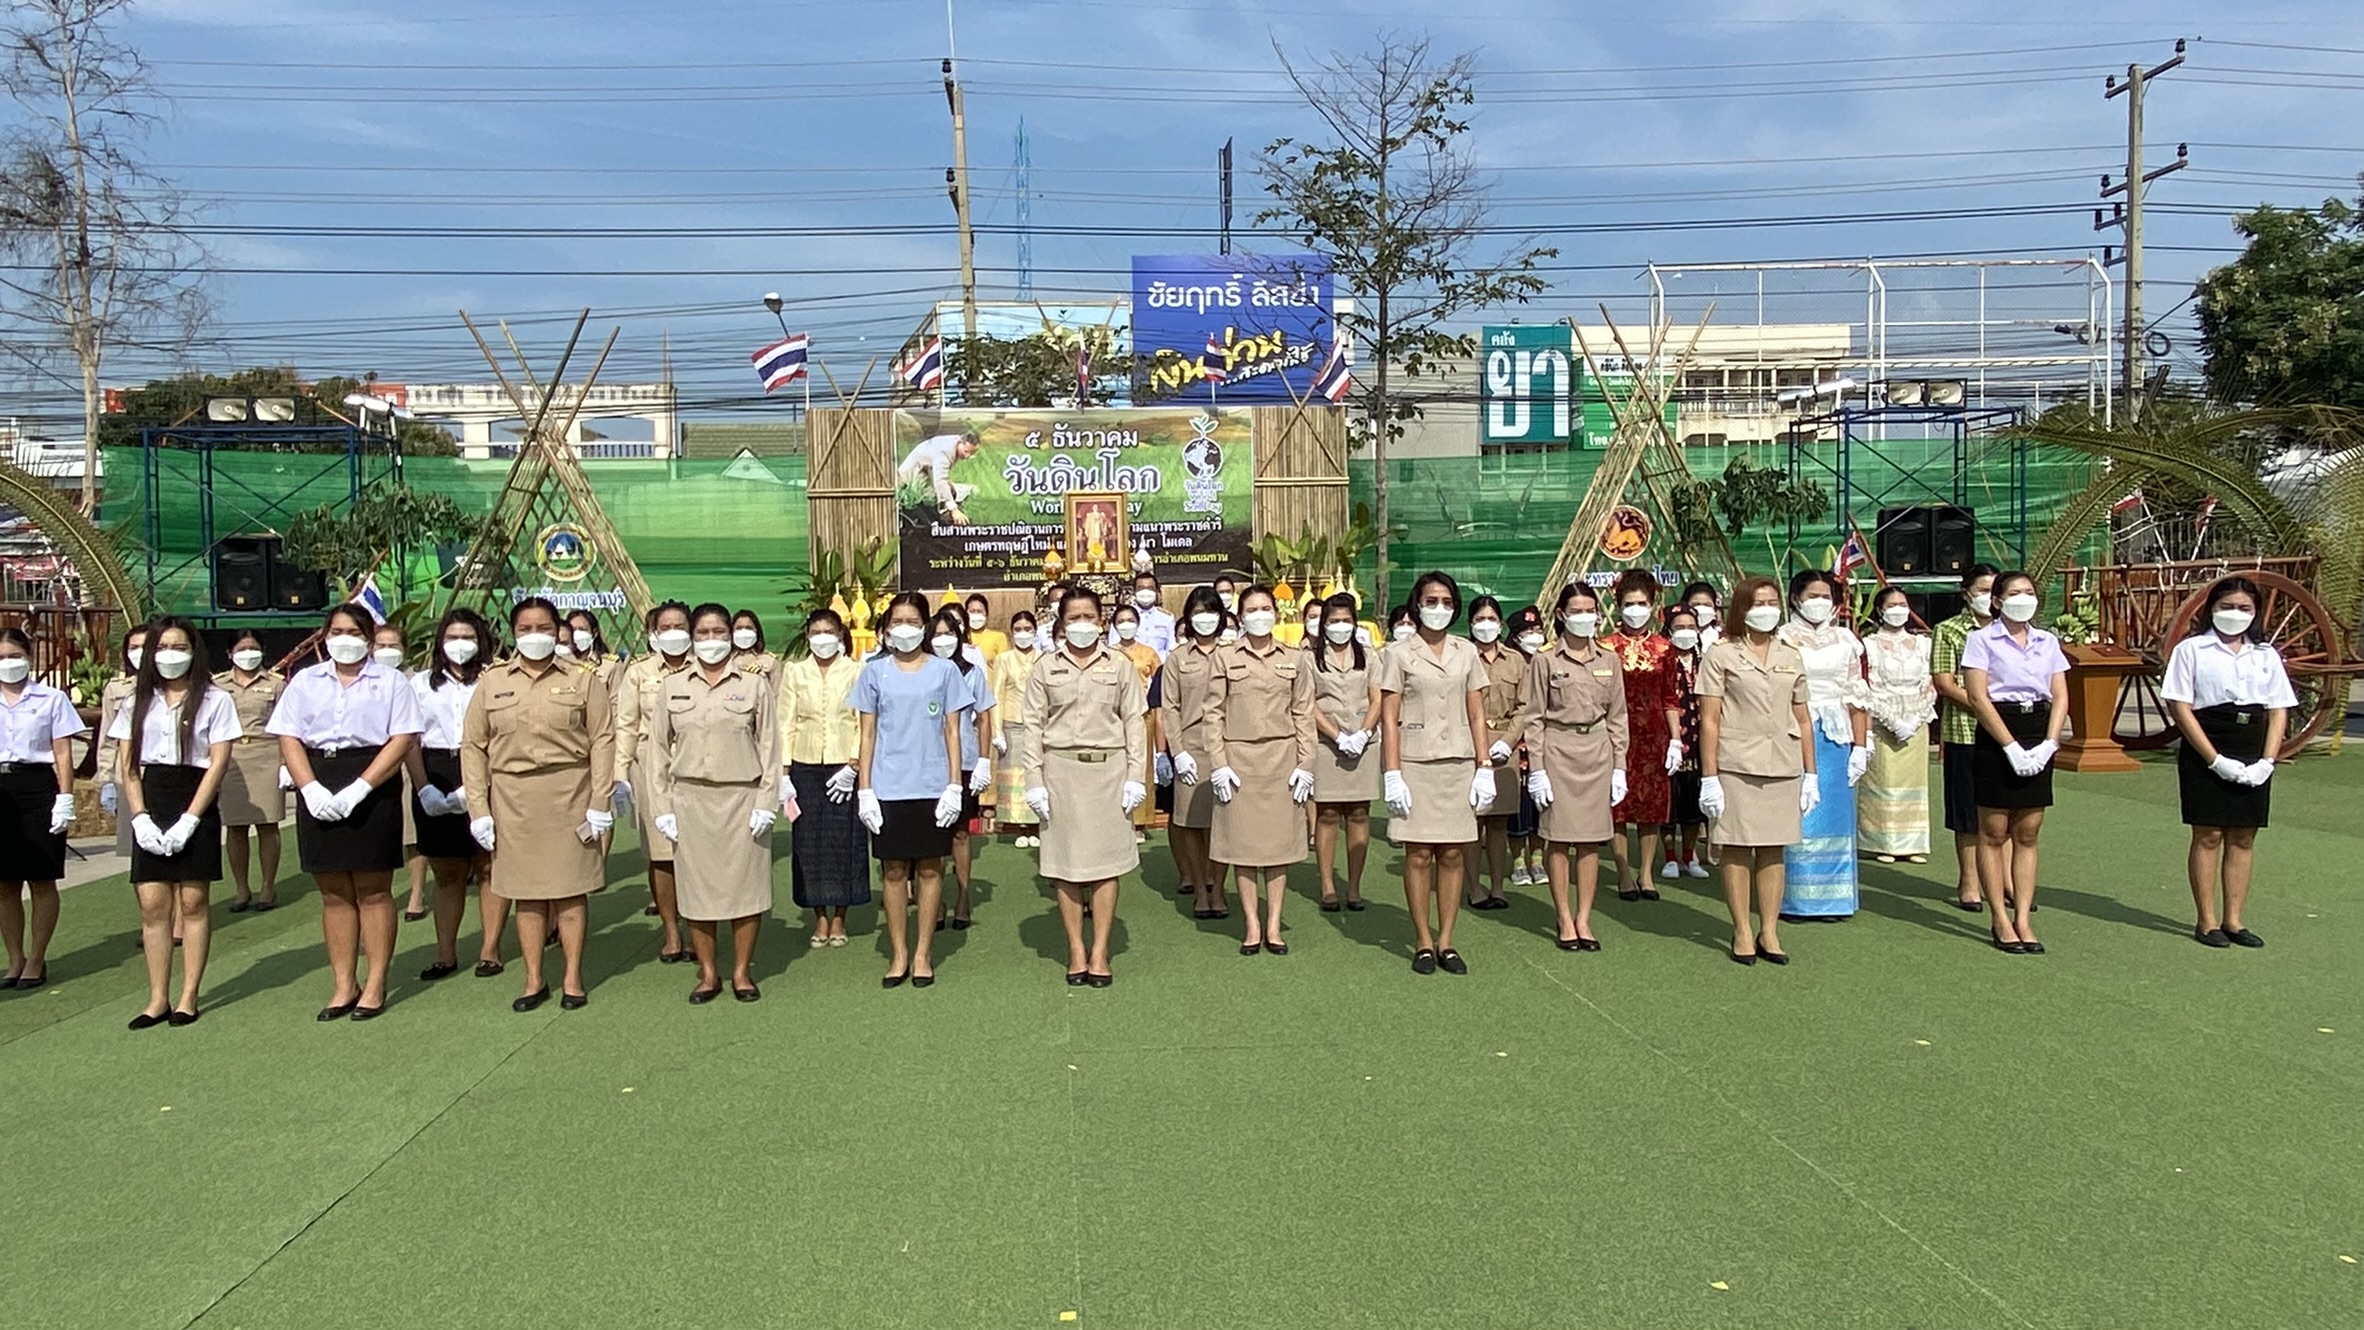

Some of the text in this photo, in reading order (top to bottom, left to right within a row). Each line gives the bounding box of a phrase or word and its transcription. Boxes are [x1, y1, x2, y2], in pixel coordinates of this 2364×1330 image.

[1147, 273, 1243, 316] ชัยฤทธิ์
[1487, 349, 1570, 438] ยา
[1024, 422, 1138, 448] ๕ ธันวาคม
[1003, 448, 1160, 494] วันดินโลก
[1030, 499, 1065, 515] Worl
